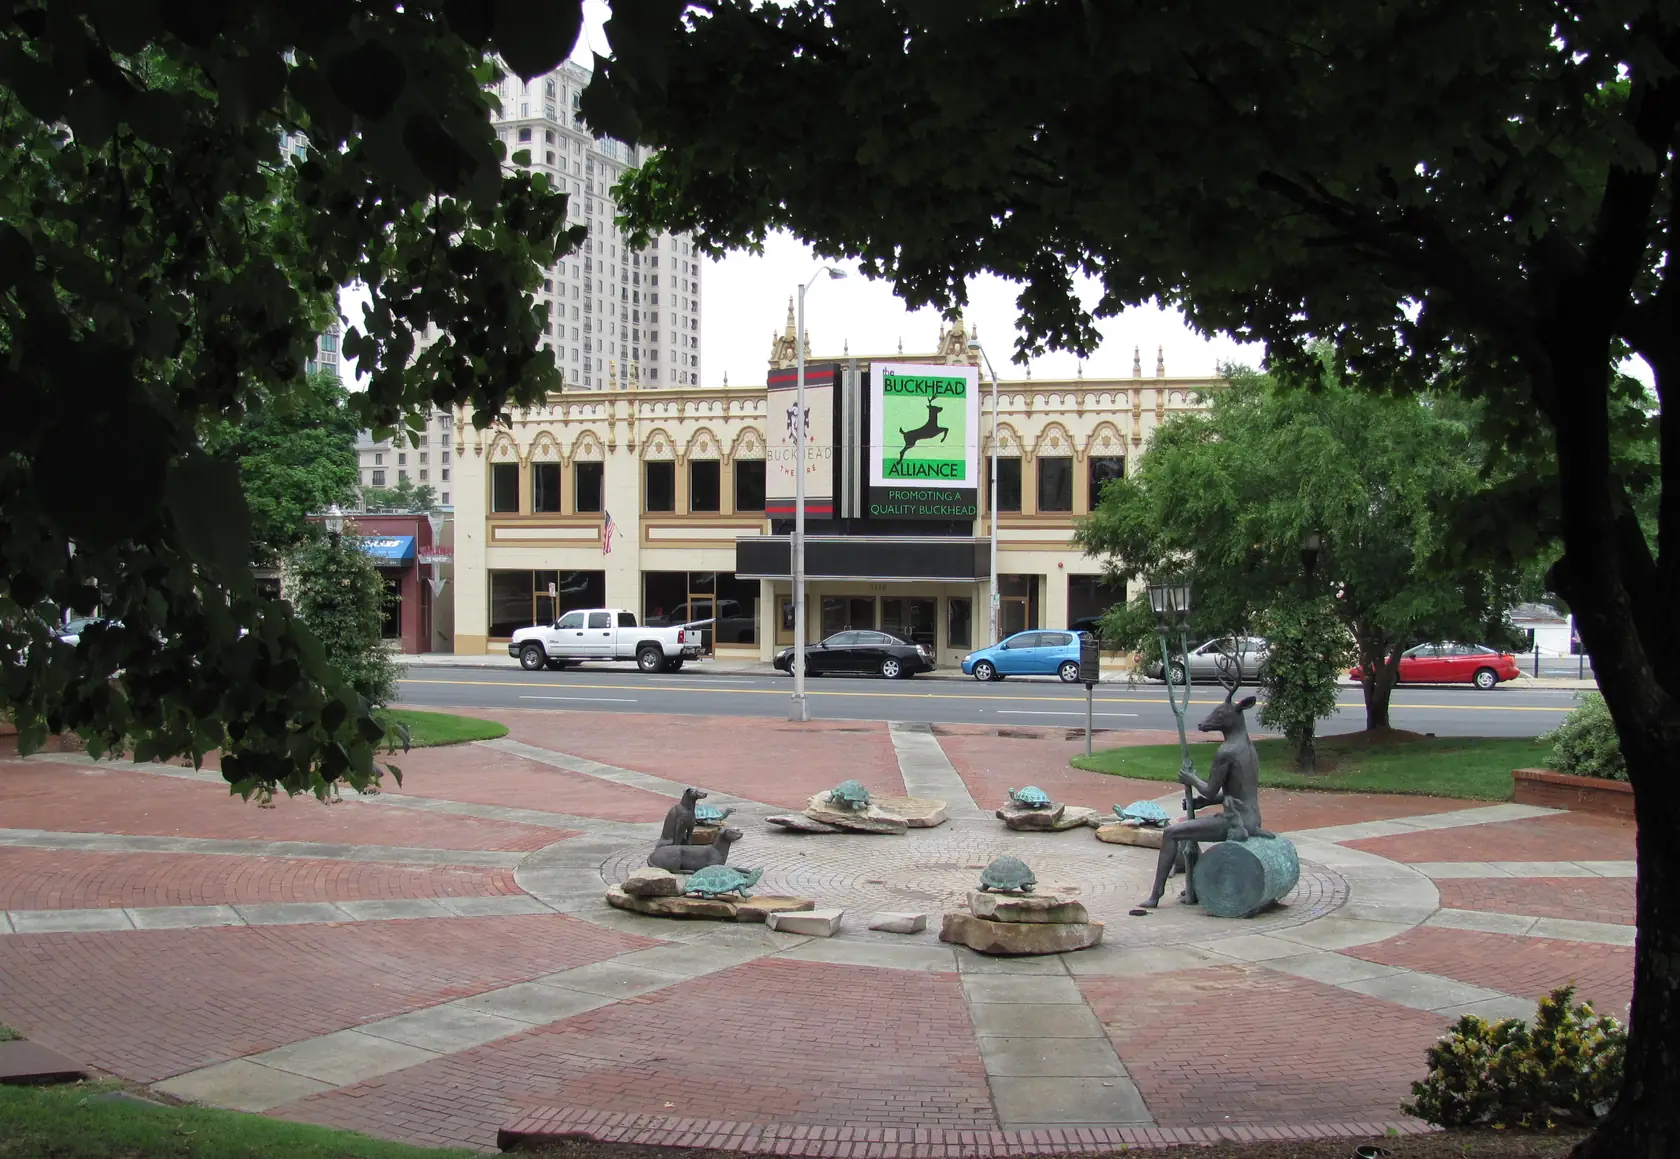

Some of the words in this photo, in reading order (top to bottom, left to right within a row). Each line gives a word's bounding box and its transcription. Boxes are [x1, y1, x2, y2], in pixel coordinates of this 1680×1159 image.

[883, 366, 895, 376] the
[884, 378, 965, 395] BUCKHEAD
[780, 464, 817, 477] THERE
[888, 462, 958, 477] ALLIANCE
[889, 491, 952, 501] PROMOTING
[954, 491, 962, 501] A
[870, 504, 916, 515] QUALITY
[919, 505, 976, 516] BUCKHEAD
